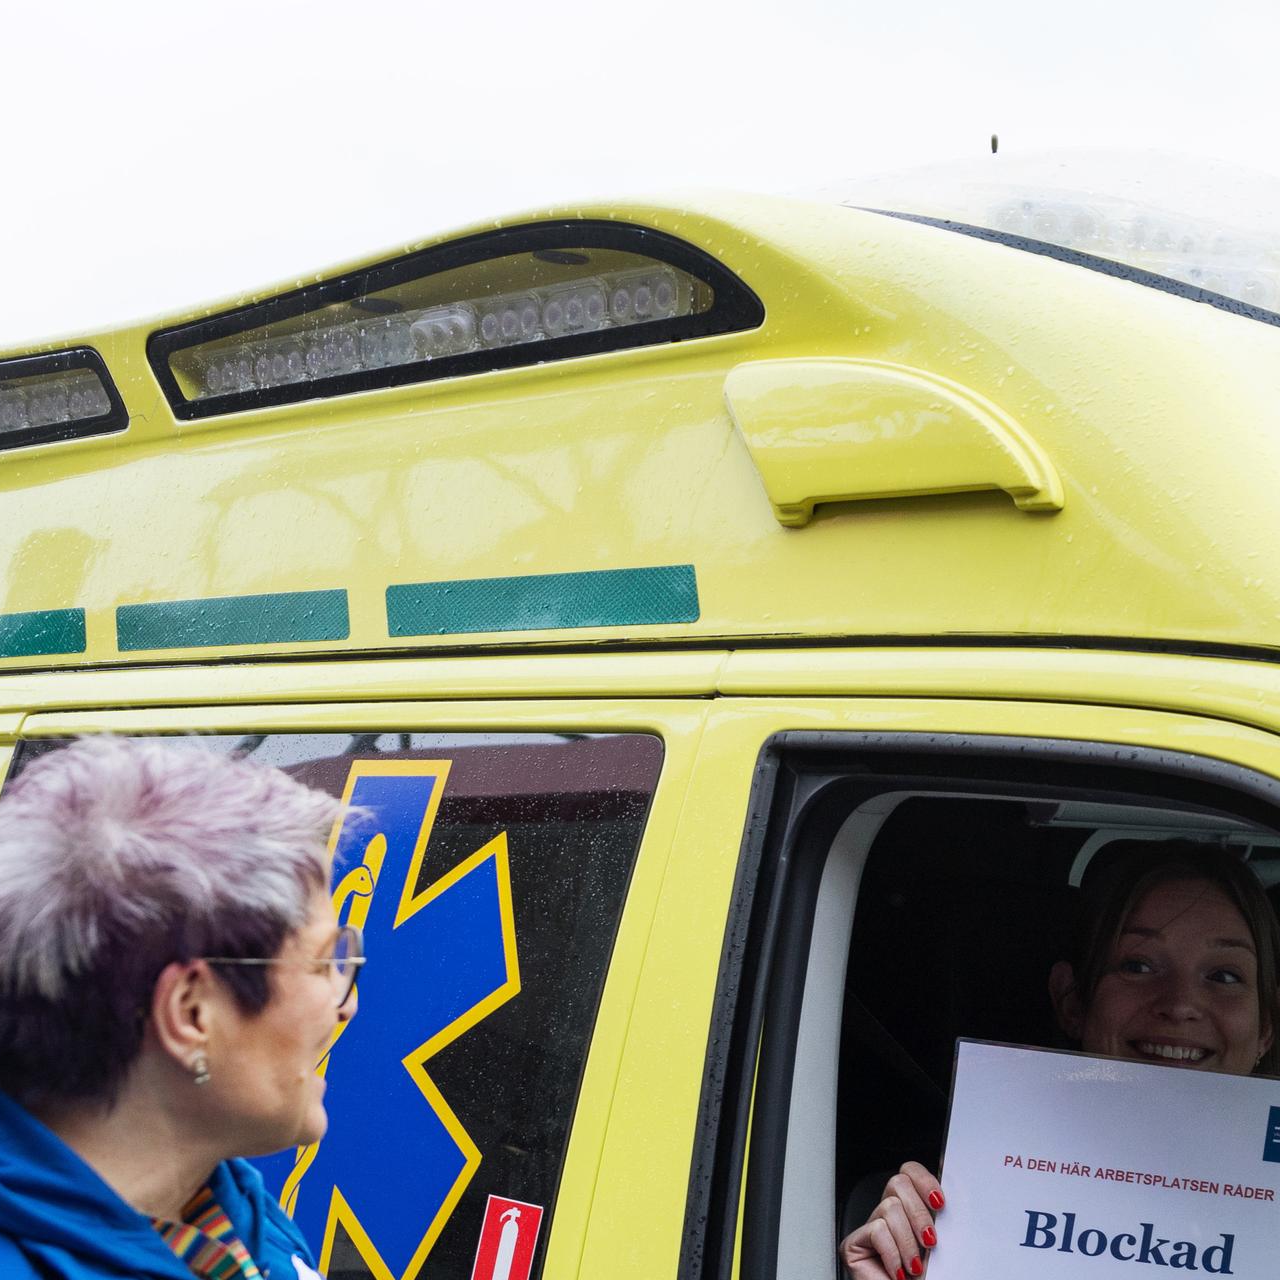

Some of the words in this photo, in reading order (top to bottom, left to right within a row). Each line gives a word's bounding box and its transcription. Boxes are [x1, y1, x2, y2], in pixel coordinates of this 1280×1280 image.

[1004, 1155, 1023, 1169] PÅ
[1027, 1158, 1056, 1173] DEN
[1060, 1162, 1091, 1178] HÄR
[1094, 1168, 1219, 1194] ARBETSPLATSEN
[1223, 1184, 1275, 1201] RÅDER
[1019, 1209, 1235, 1275] Blockad
